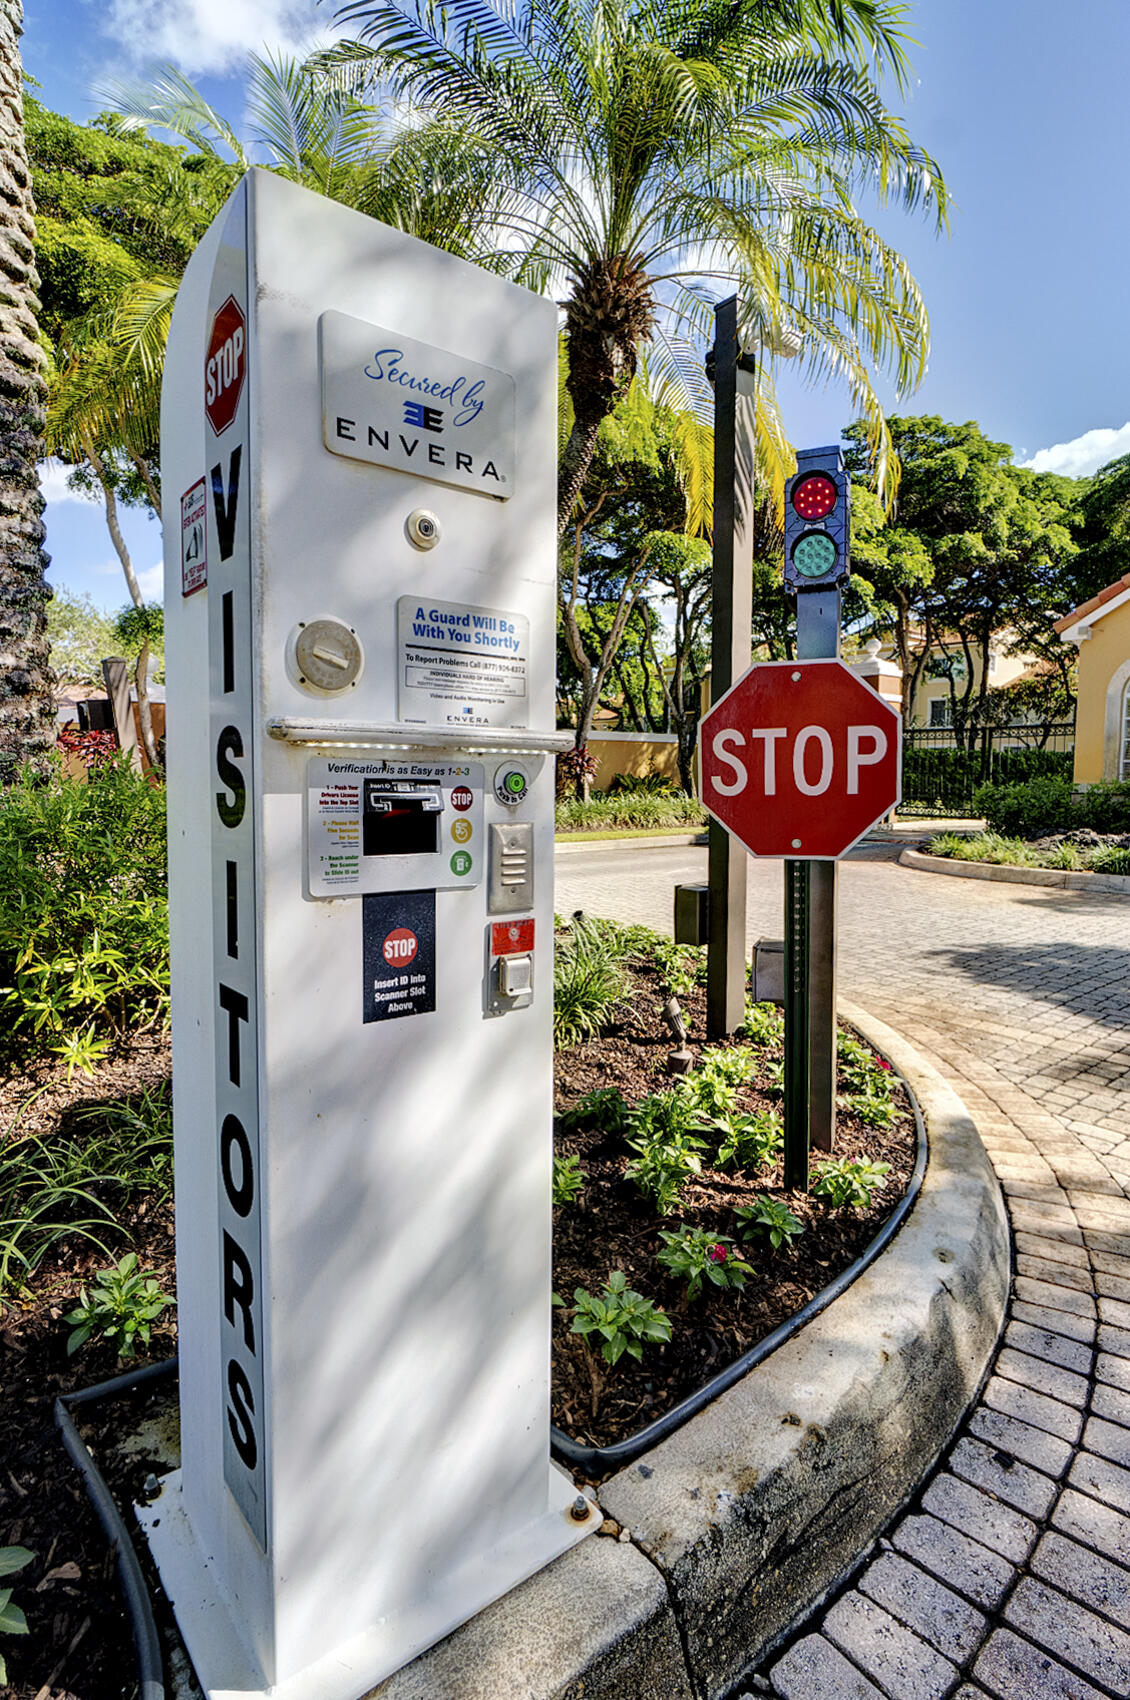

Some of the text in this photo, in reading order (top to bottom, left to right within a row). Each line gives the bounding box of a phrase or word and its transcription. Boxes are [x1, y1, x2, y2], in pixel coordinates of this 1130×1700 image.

[206, 326, 244, 406] STOP
[364, 349, 486, 426] Secured by
[416, 607, 515, 634] A Guard Will Be
[412, 624, 520, 652] With You Shortly
[406, 653, 414, 662] To
[415, 654, 438, 664] Report
[439, 657, 468, 668] Problems
[446, 715, 489, 724] ENVERA
[328, 763, 385, 774] Verification
[386, 764, 394, 774] is
[410, 766, 432, 776] Easy
[448, 767, 470, 776] 1-2-3
[711, 725, 888, 796] STOP
[452, 792, 472, 806] STOP
[210, 443, 258, 1470] VISITORS
[384, 938, 416, 959] STOP
[374, 974, 426, 990] Insert ID Into
[374, 986, 426, 1002] Scanner Slot
[388, 1002, 413, 1013] Above
